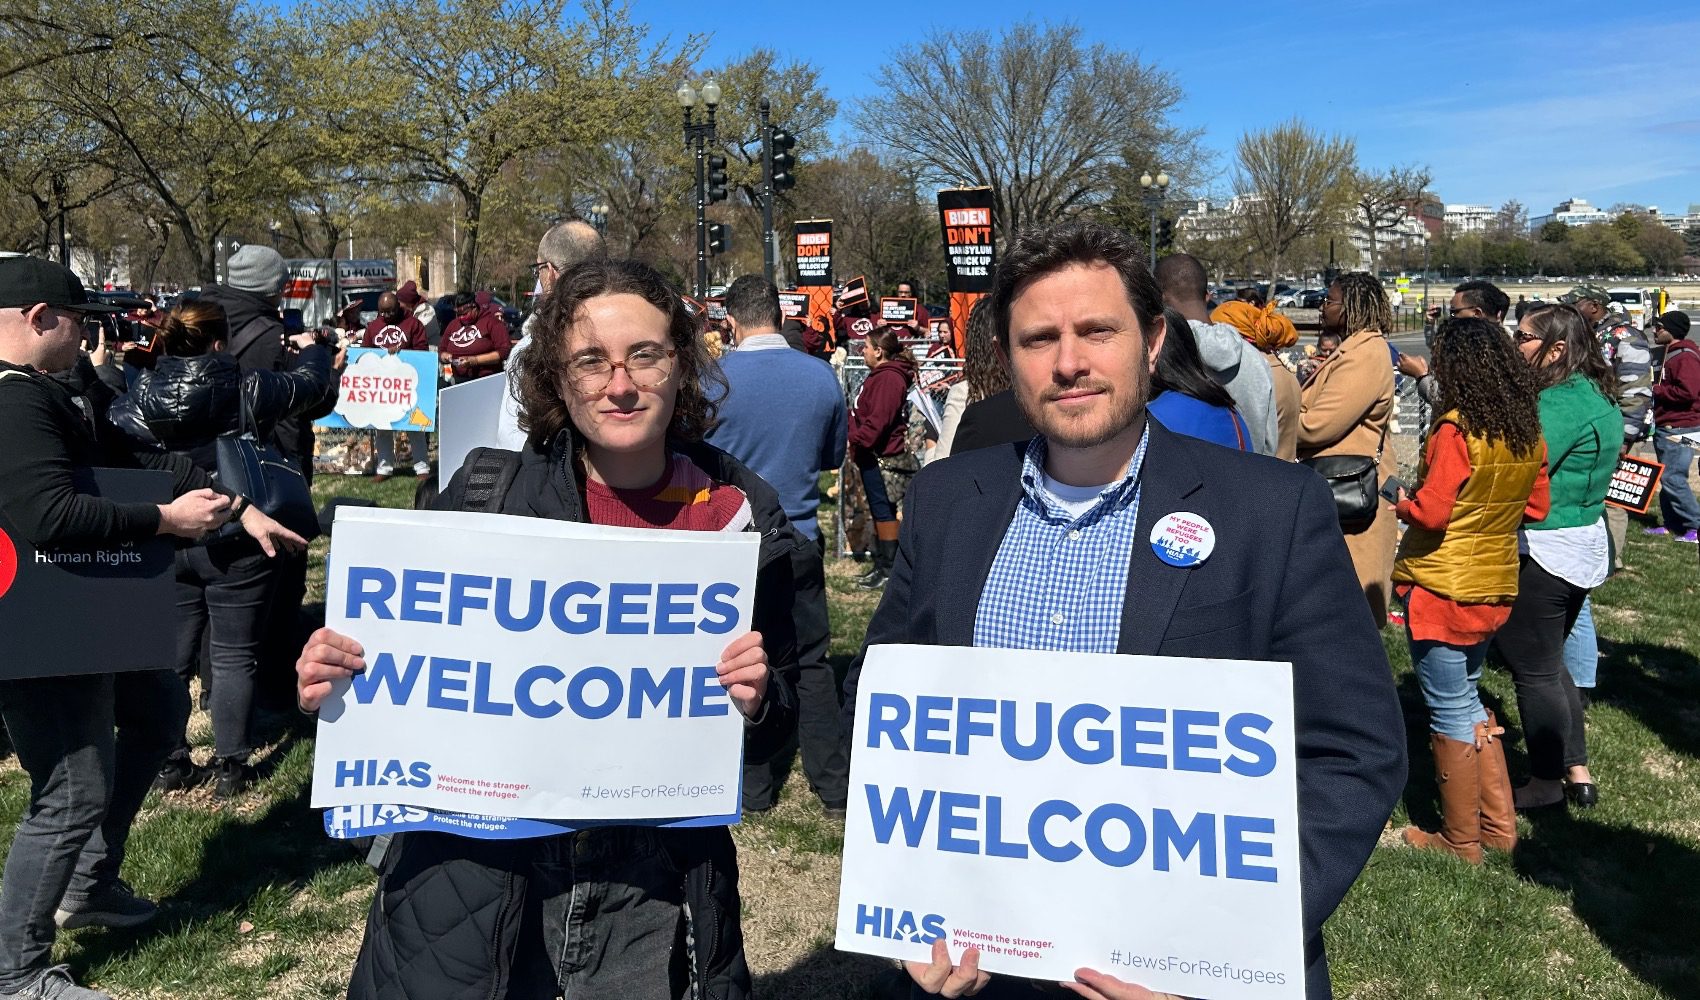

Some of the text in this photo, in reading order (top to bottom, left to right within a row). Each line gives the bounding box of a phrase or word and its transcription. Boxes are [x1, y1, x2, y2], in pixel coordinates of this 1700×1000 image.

[948, 210, 988, 226] BIDEN
[799, 233, 828, 245] BIDEN
[947, 227, 991, 245] DON'T
[797, 245, 829, 257] DON'T
[979, 256, 992, 266] UP
[341, 268, 388, 278] U-HAUL
[374, 327, 408, 346] CASA
[450, 327, 482, 343] CASA
[342, 376, 412, 391] RESTORE
[347, 391, 411, 405] ASYLUM
[1621, 461, 1653, 476] IN CH
[1612, 469, 1650, 487] DETAI
[1609, 479, 1645, 496] BIDEN
[1177, 524, 1198, 534] WERE
[1181, 519, 1209, 533] PEOPLE
[1166, 527, 1203, 543] REFUGEES
[1174, 536, 1189, 544] TOO
[35, 549, 142, 566] Human Rights
[1166, 548, 1185, 559] HIAS
[344, 566, 741, 635] REFUGEES
[350, 651, 729, 720] WELCOME
[866, 692, 1277, 778] REFUGEES
[335, 760, 431, 788] HIAS
[438, 774, 531, 791] Welcome the stranger.
[436, 783, 520, 800] Protect the refugee.
[582, 784, 725, 799] #JewsForRefugees
[433, 815, 507, 831] Protect the refugee.
[864, 783, 1279, 883] WELCOME
[855, 903, 947, 945] HIAS
[952, 928, 1055, 949] Welcome the stranger.
[952, 939, 1042, 960] Protect the refugee.
[1110, 949, 1286, 985] #JewsForRefugees
